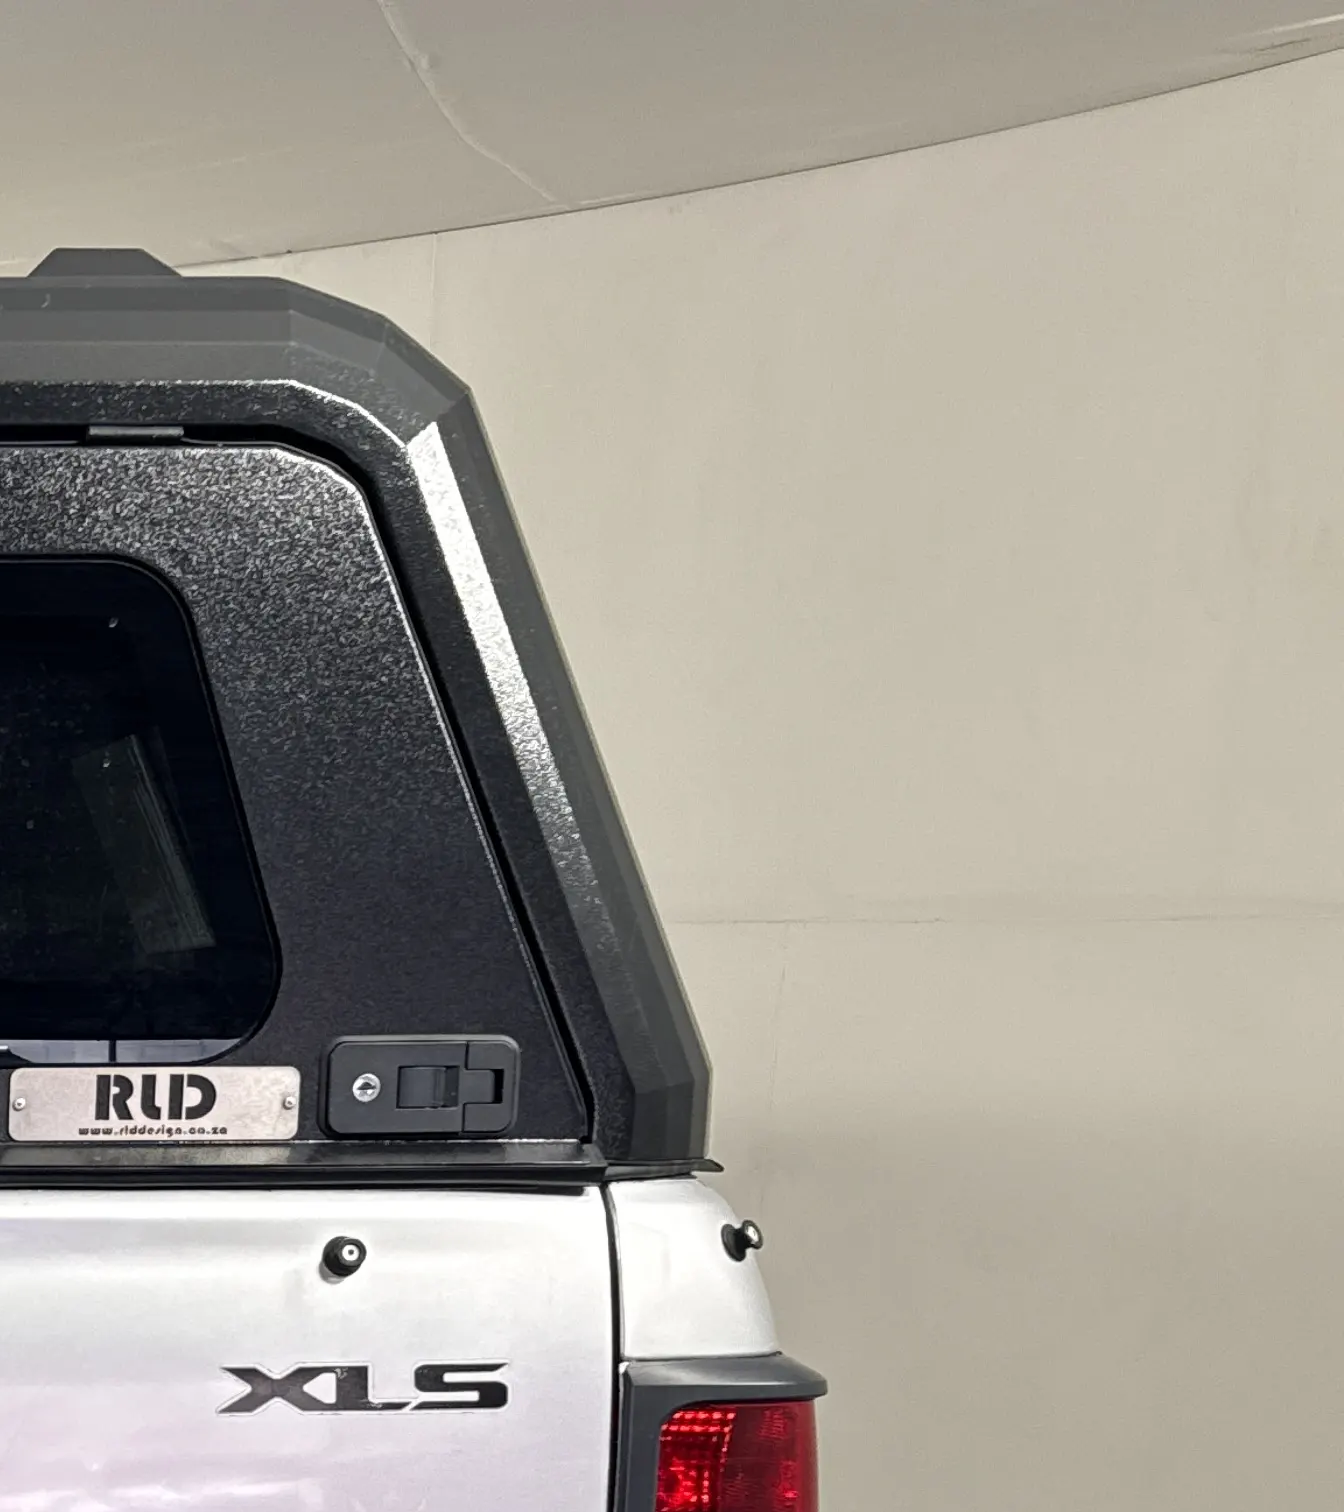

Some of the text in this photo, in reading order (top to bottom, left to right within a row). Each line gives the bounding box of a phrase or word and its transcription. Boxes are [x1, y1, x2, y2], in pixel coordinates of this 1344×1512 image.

[94, 1073, 218, 1121] RLD
[78, 1124, 228, 1138] www.rlddesign.co.za
[215, 1361, 510, 1414] XLS
